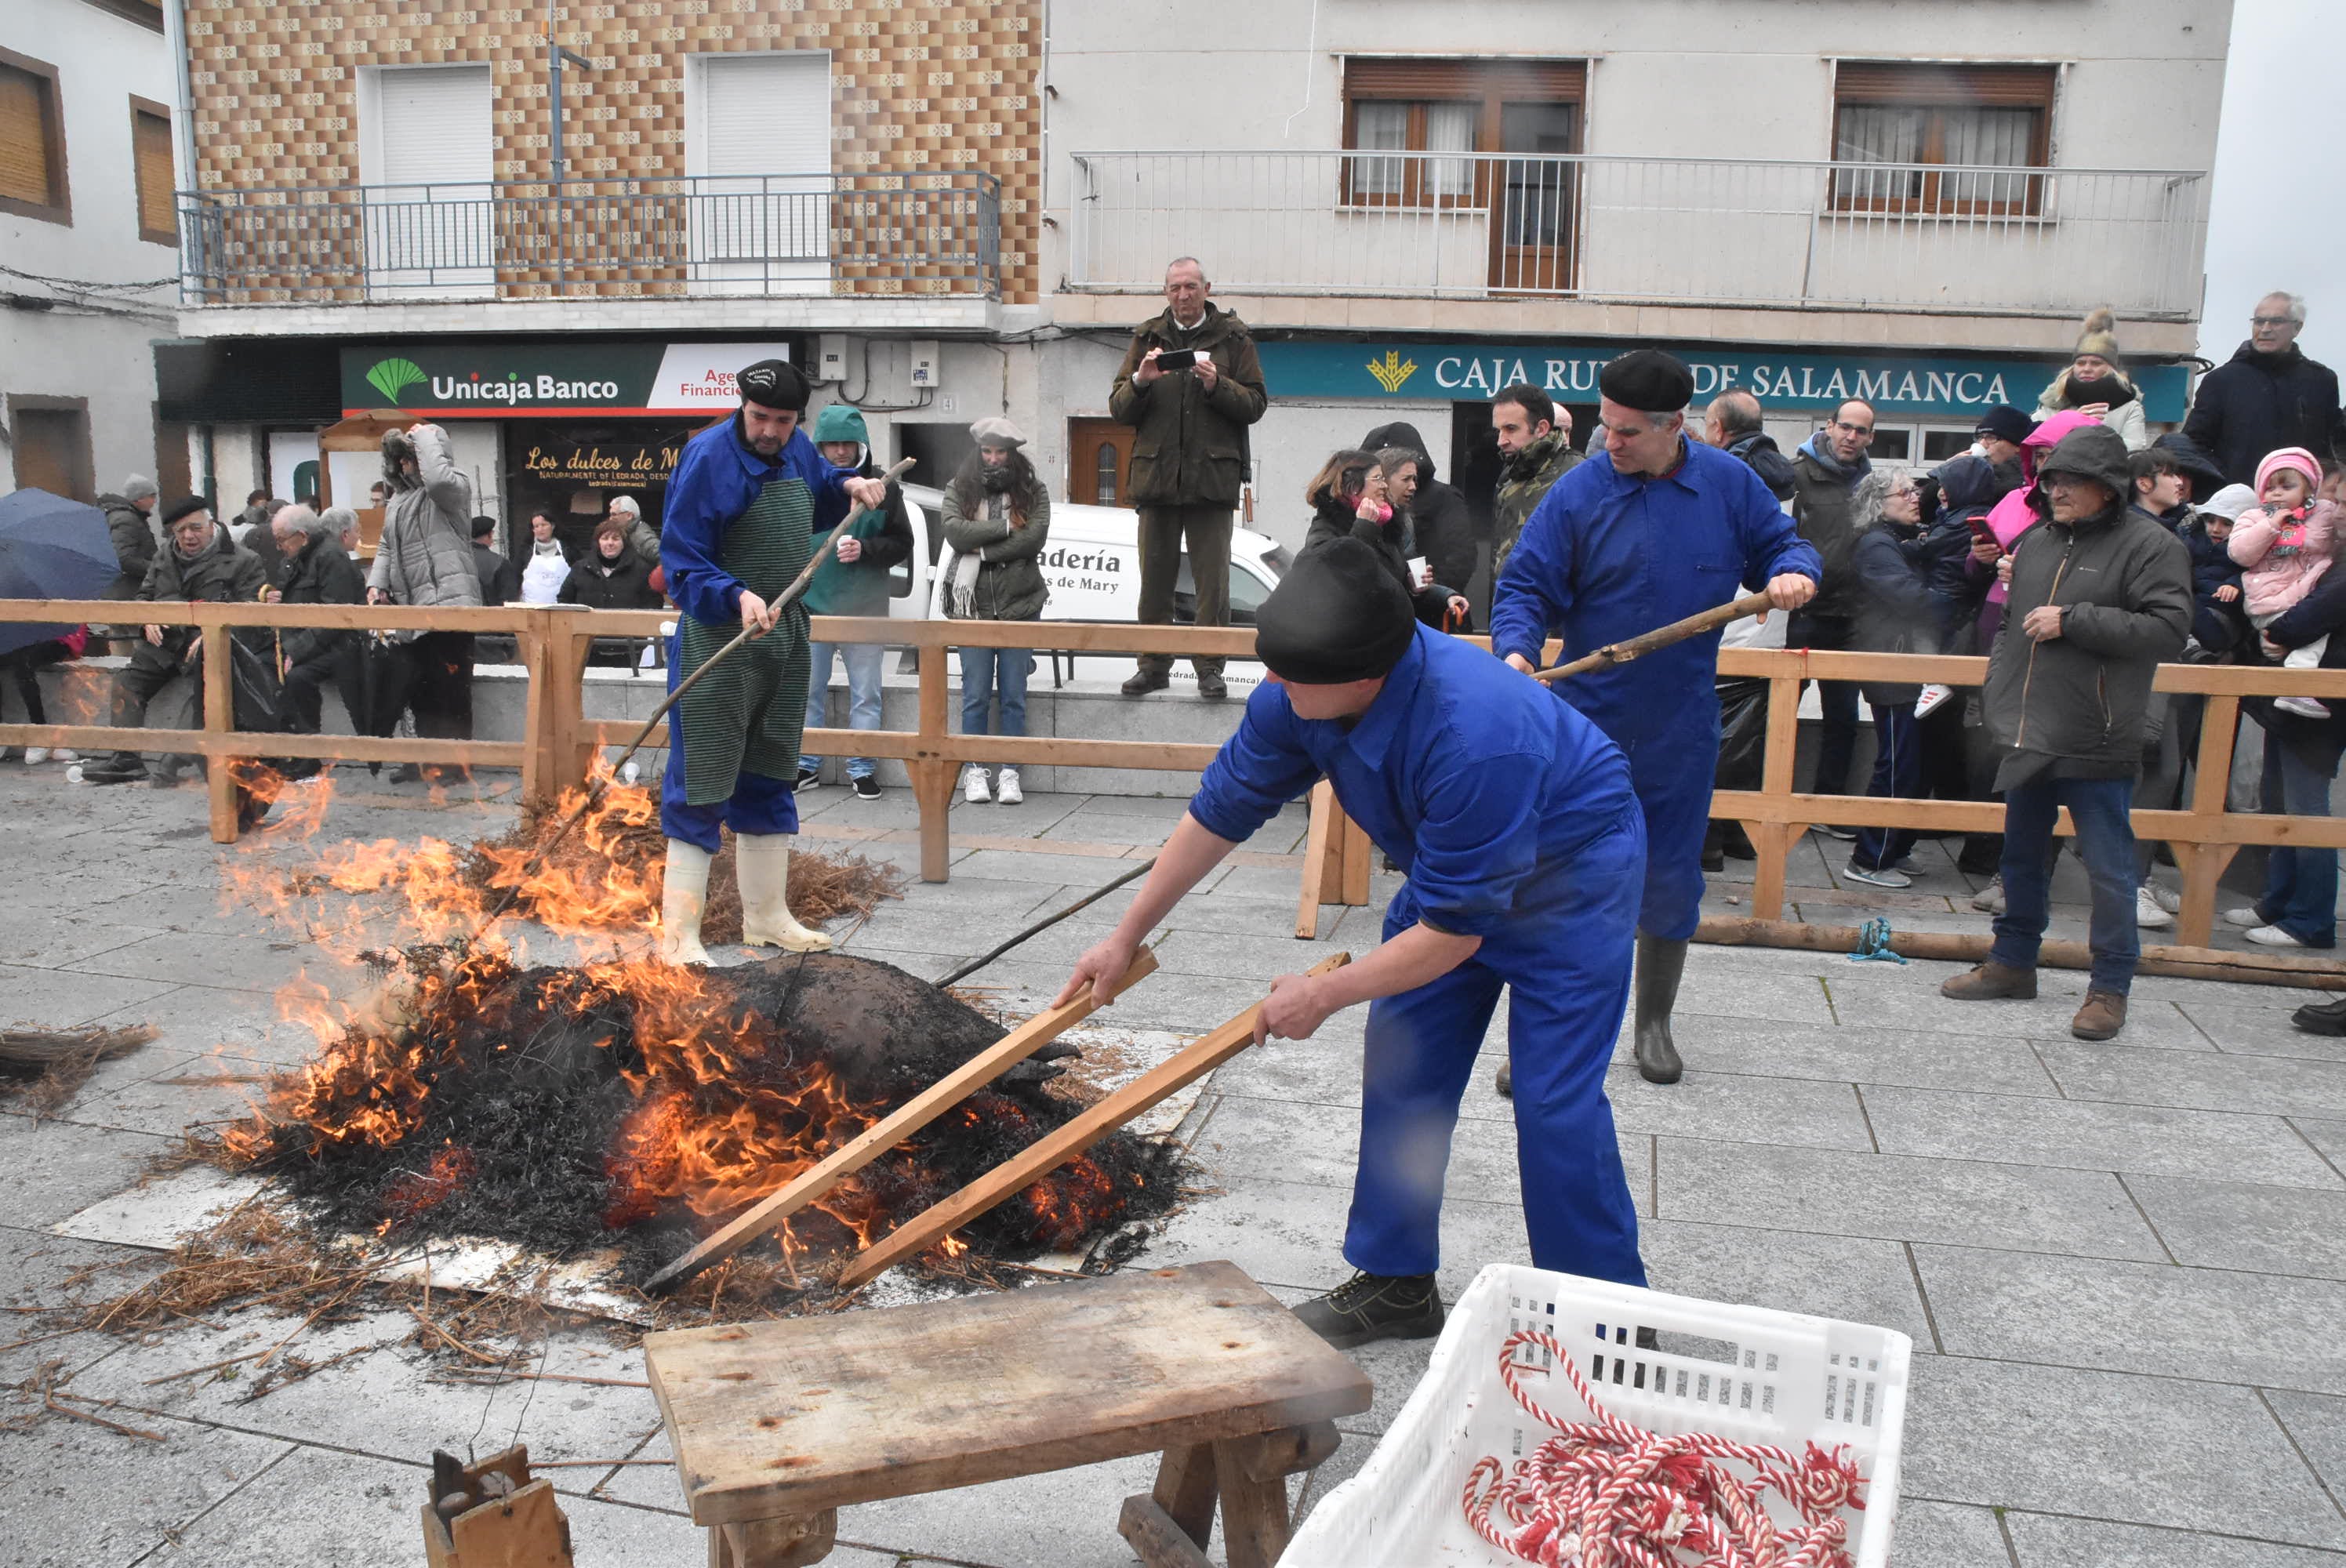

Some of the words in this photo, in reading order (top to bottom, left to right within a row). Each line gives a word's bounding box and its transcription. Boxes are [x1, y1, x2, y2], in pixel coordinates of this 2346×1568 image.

[433, 372, 533, 405] Unicaja
[537, 375, 619, 398] Banco
[705, 369, 735, 386] Age
[1435, 358, 1528, 397] CAJA
[1544, 360, 1610, 390] RU
[1689, 364, 1739, 394] DE
[1751, 365, 2010, 405] SALAMANCA
[525, 446, 558, 470] Los
[567, 448, 623, 470] dulces
[631, 448, 653, 470] de
[660, 447, 679, 470] M
[1036, 548, 1120, 572] adería
[1057, 577, 1075, 588] de
[1079, 577, 1119, 594] Mary
